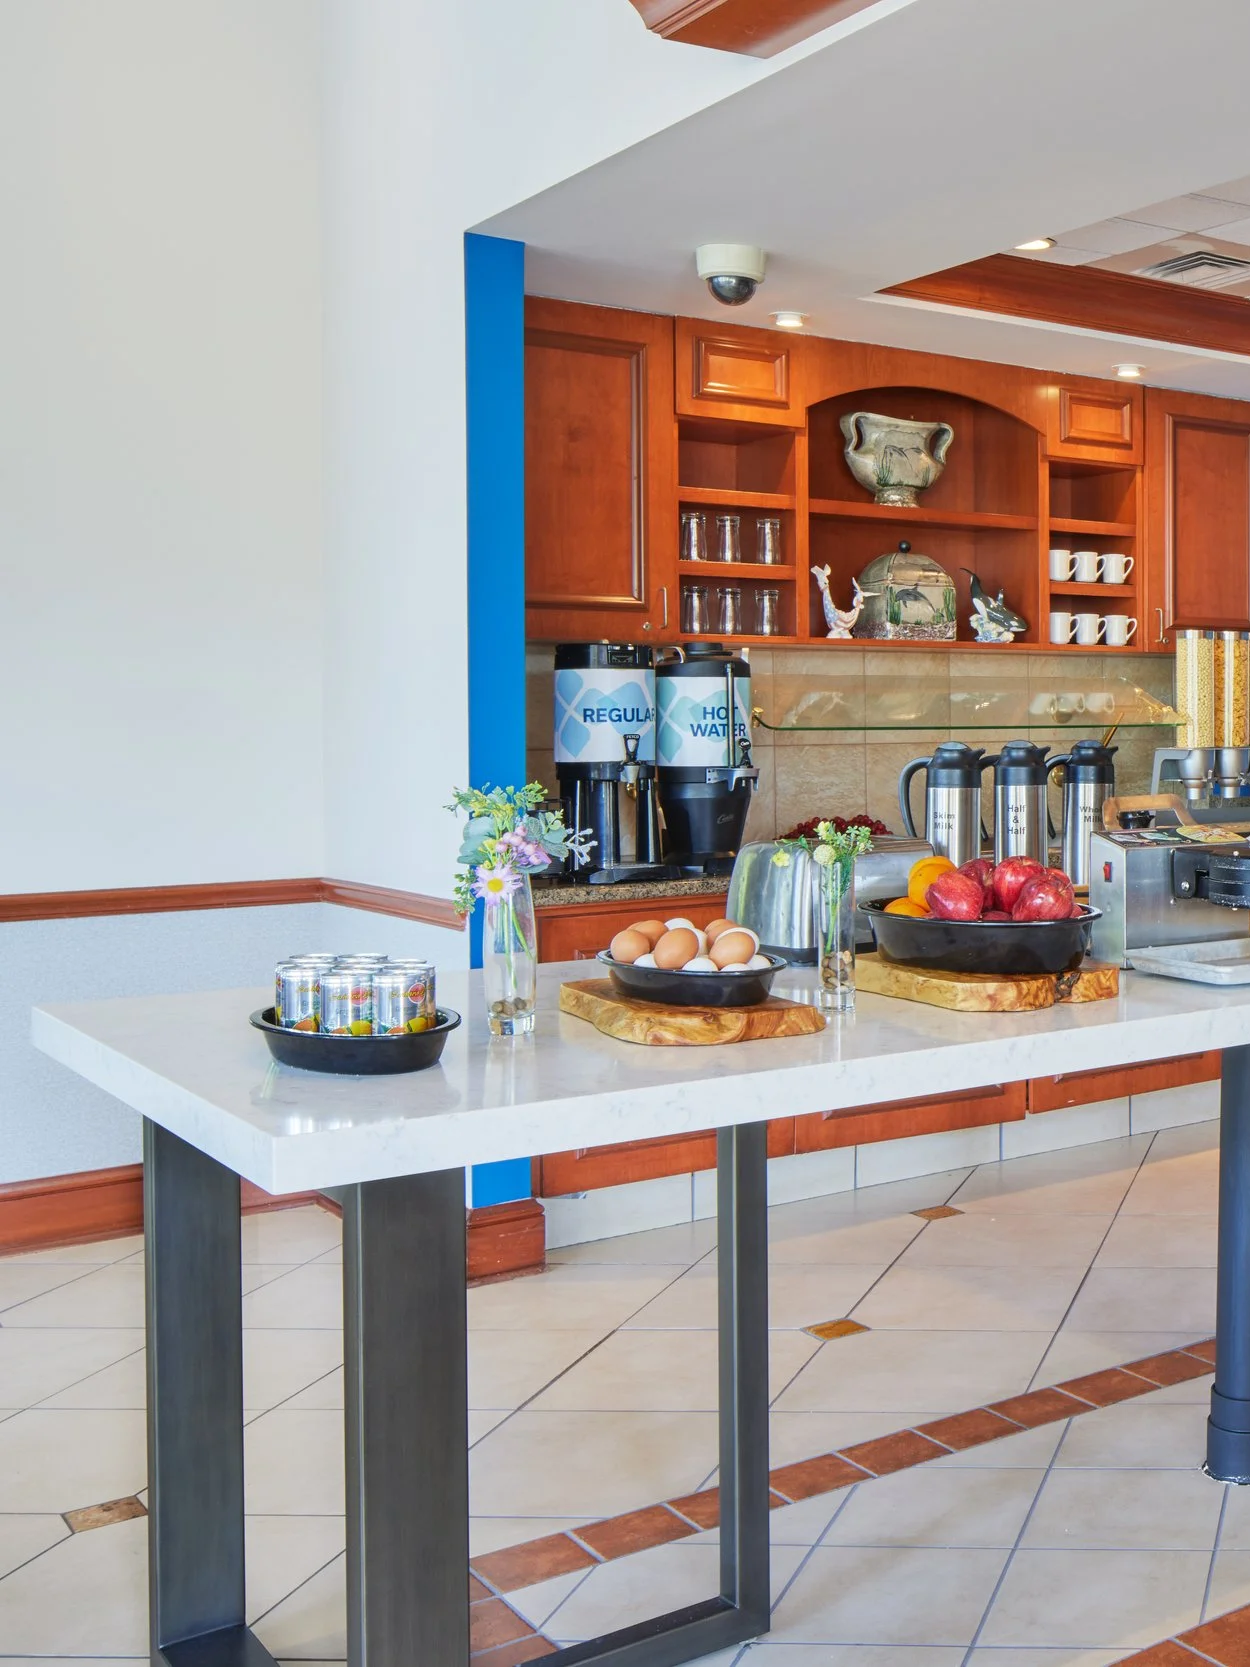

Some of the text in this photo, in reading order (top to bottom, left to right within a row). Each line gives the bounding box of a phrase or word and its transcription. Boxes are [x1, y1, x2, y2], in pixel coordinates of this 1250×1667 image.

[690, 723, 747, 737] WATER
[1007, 805, 1027, 813] Half
[933, 812, 956, 820] Skim
[934, 822, 954, 830] Milk
[1007, 827, 1026, 835] Half
